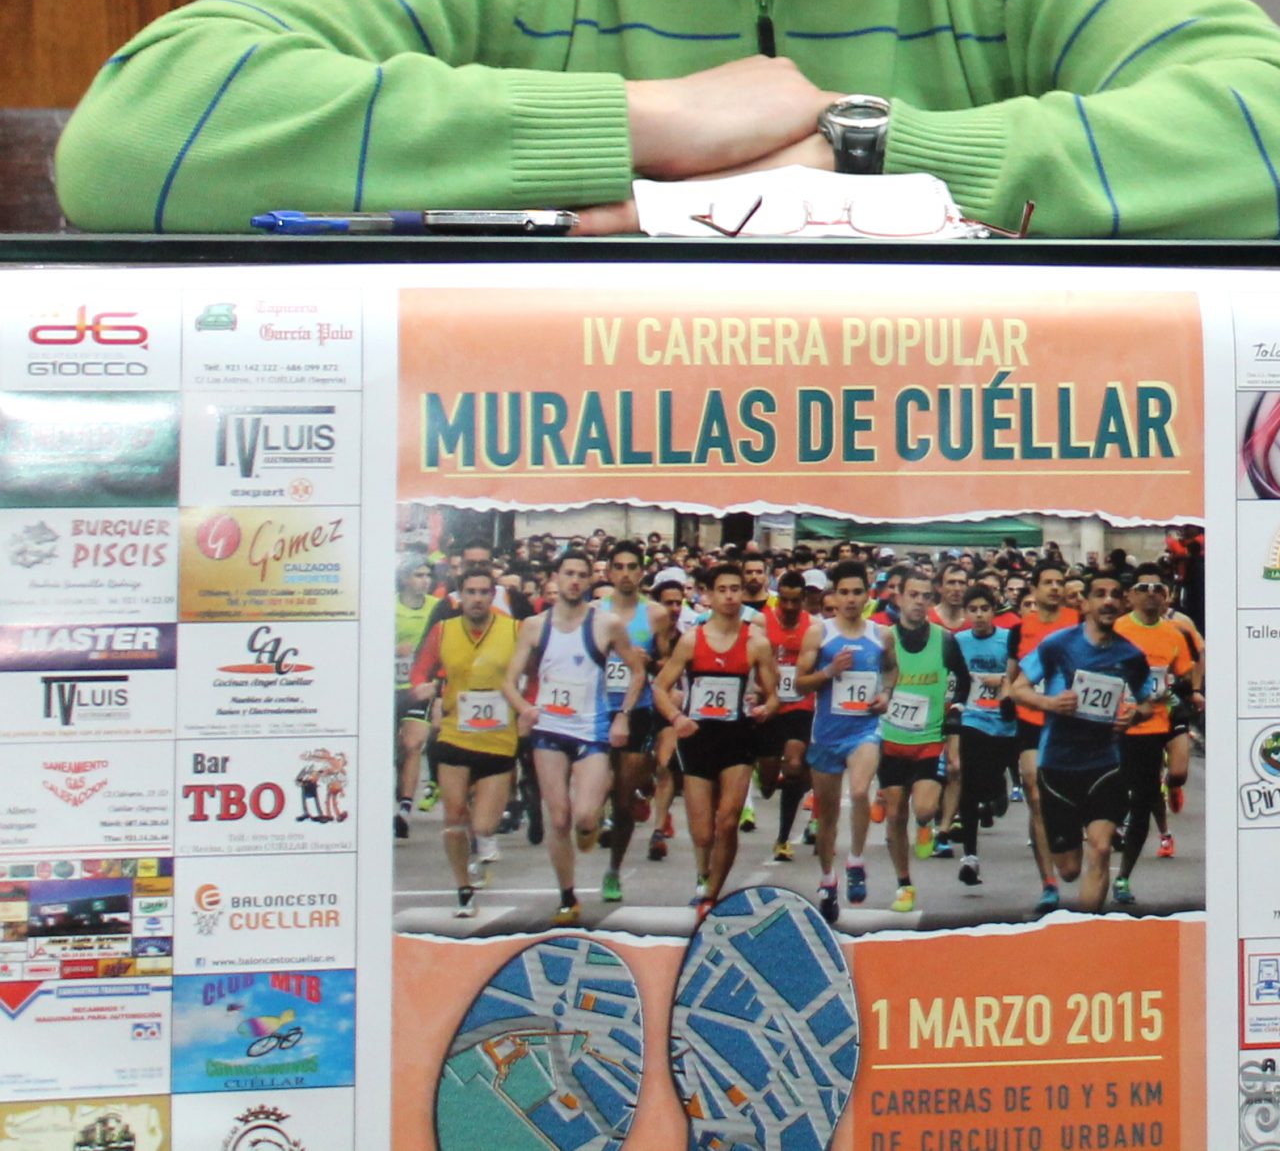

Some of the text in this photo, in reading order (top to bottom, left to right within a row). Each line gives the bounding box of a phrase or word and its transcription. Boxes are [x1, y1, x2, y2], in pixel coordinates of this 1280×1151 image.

[584, 316, 1029, 366] IV CARRERA POPULAR
[420, 366, 1181, 472] MURALLAS DE CUÉLLAR
[231, 488, 284, 498] expert
[71, 520, 170, 536] BURGUER
[72, 544, 167, 568] PISCIS
[249, 518, 343, 582] Gómez
[284, 563, 340, 572] CALZADOS
[20, 627, 159, 651] MASTER
[607, 663, 625, 680] 25
[551, 689, 570, 707] 13
[705, 690, 725, 708] 26
[847, 686, 866, 701] 16
[979, 687, 996, 699] 29
[1080, 688, 1112, 708] 120
[472, 705, 493, 719] 20
[892, 704, 919, 720] 277
[193, 753, 230, 773] Bar
[183, 782, 285, 821] TBO
[231, 894, 337, 908] BALONCESTO
[230, 910, 340, 930] CUELLAR
[202, 972, 321, 1006] CLUB MTB
[872, 991, 1163, 1049] 1 MARZO 2015
[872, 1081, 1163, 1115] CARRERAS DE 10 Y 5 KM
[921, 1126, 1041, 1151] CIRCUITO
[1062, 1122, 1163, 1150] URBANO
